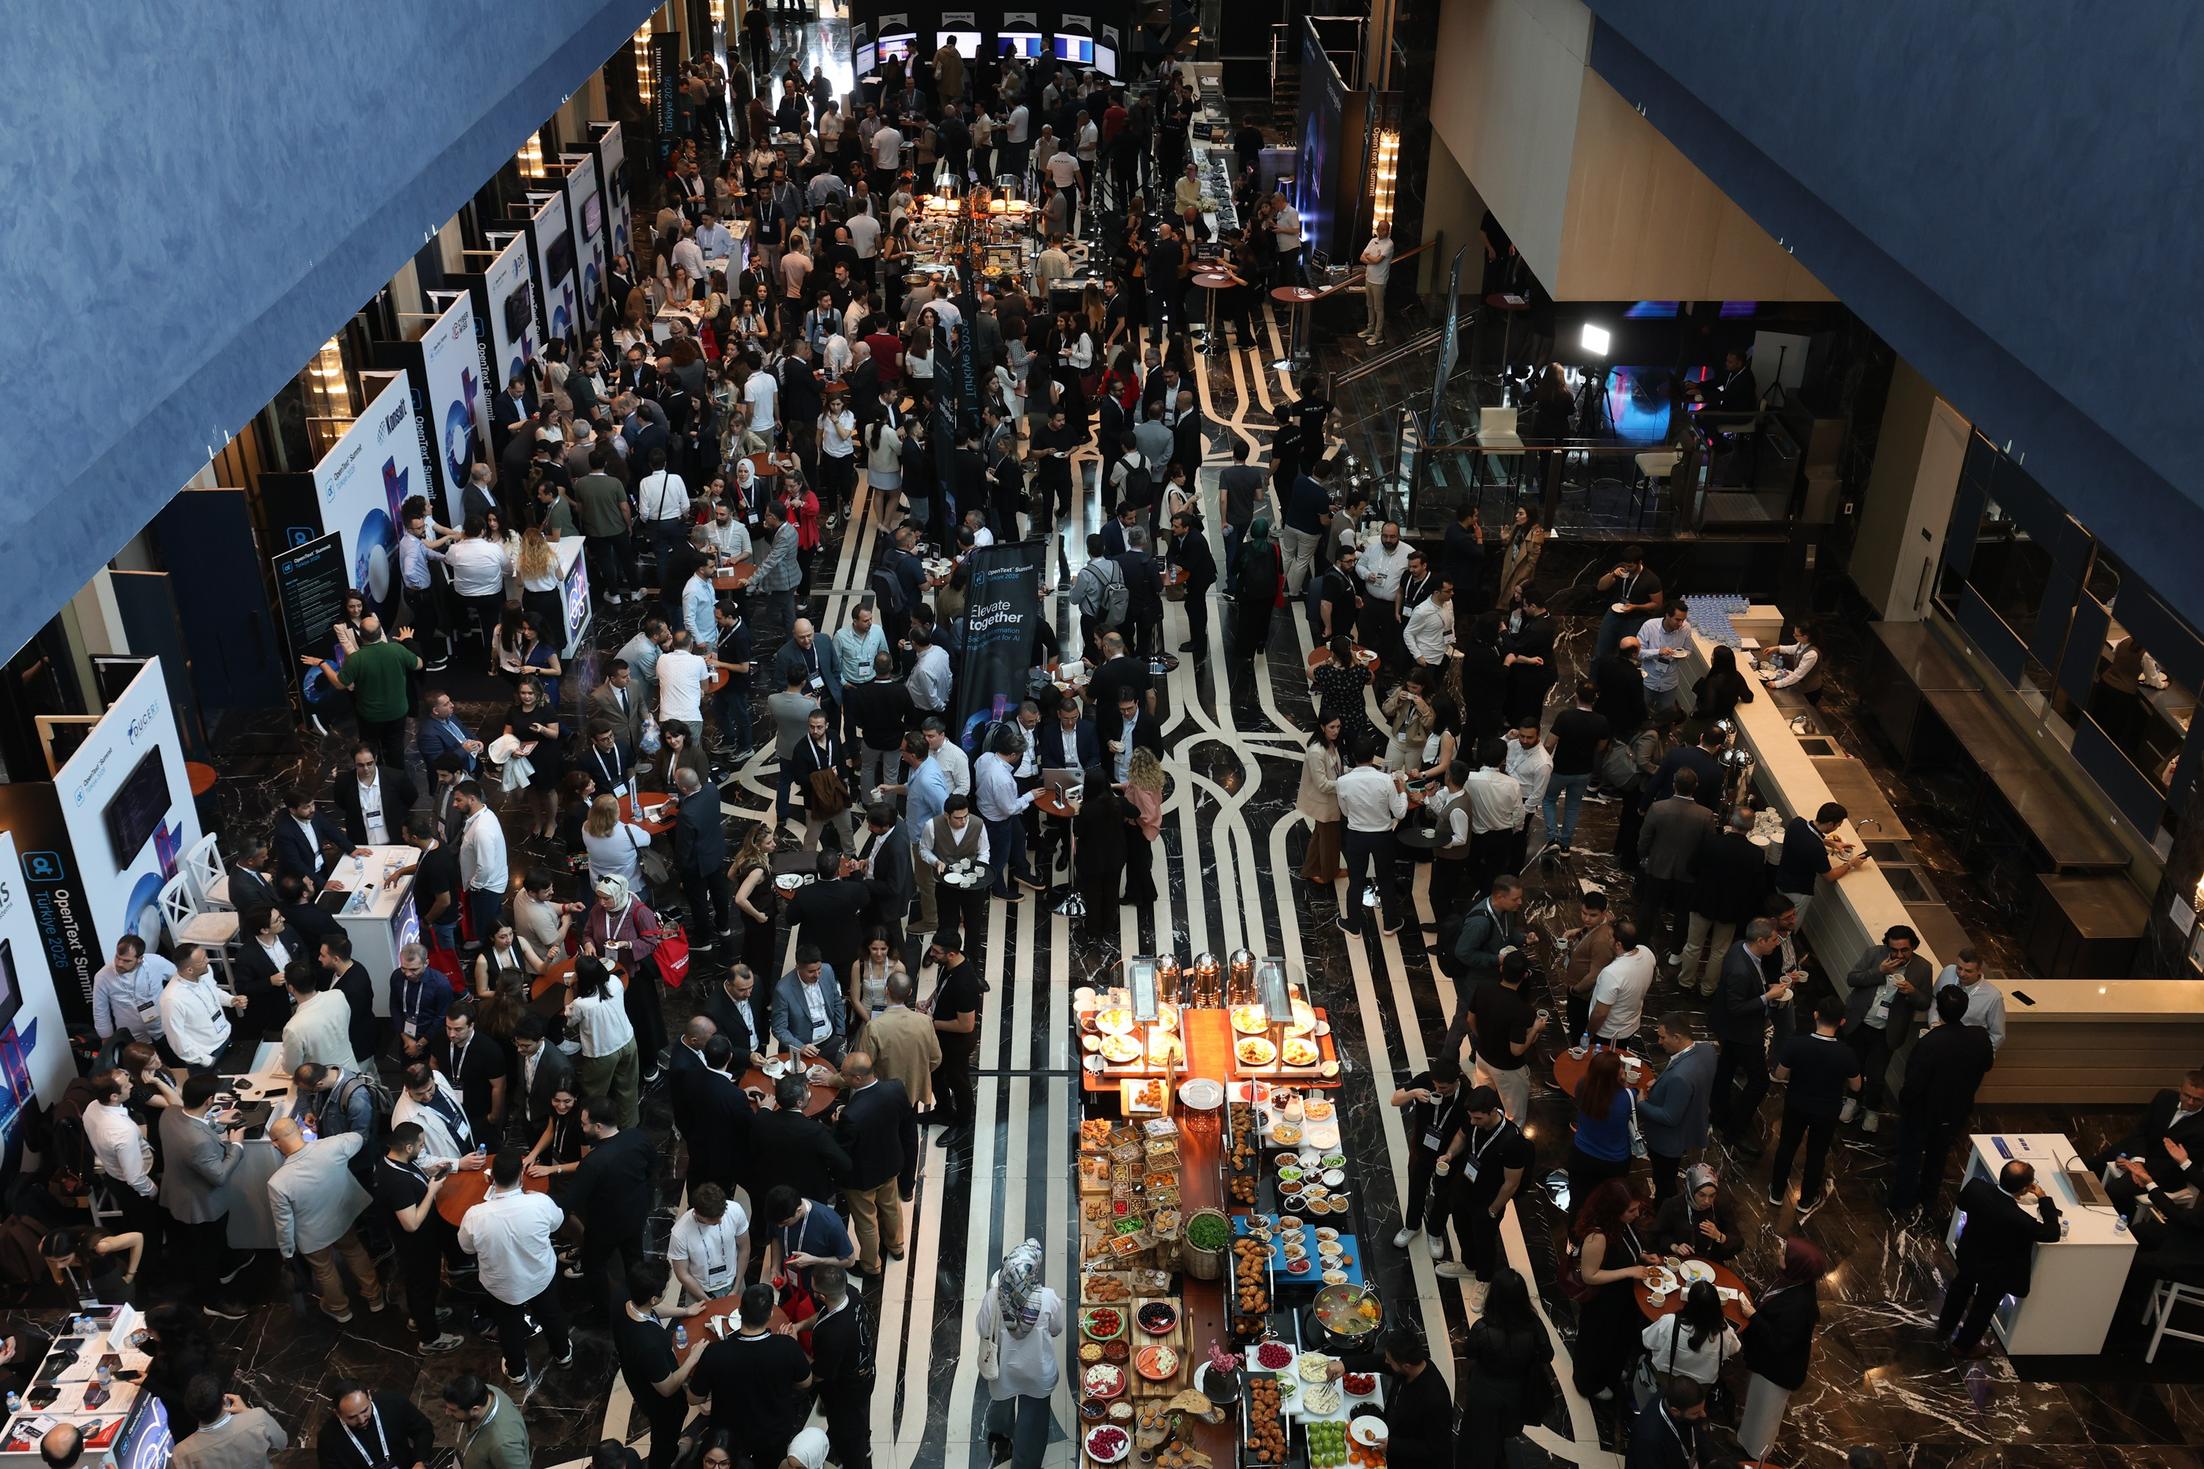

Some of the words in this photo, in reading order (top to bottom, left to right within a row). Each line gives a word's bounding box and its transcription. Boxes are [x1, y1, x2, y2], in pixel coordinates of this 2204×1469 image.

[423, 465, 437, 500] Summit
[1015, 564, 1034, 572] Summit
[971, 600, 1010, 618] Elevate
[969, 611, 1023, 632] together
[35, 890, 57, 935] Türkiye
[48, 938, 68, 969] 2026
